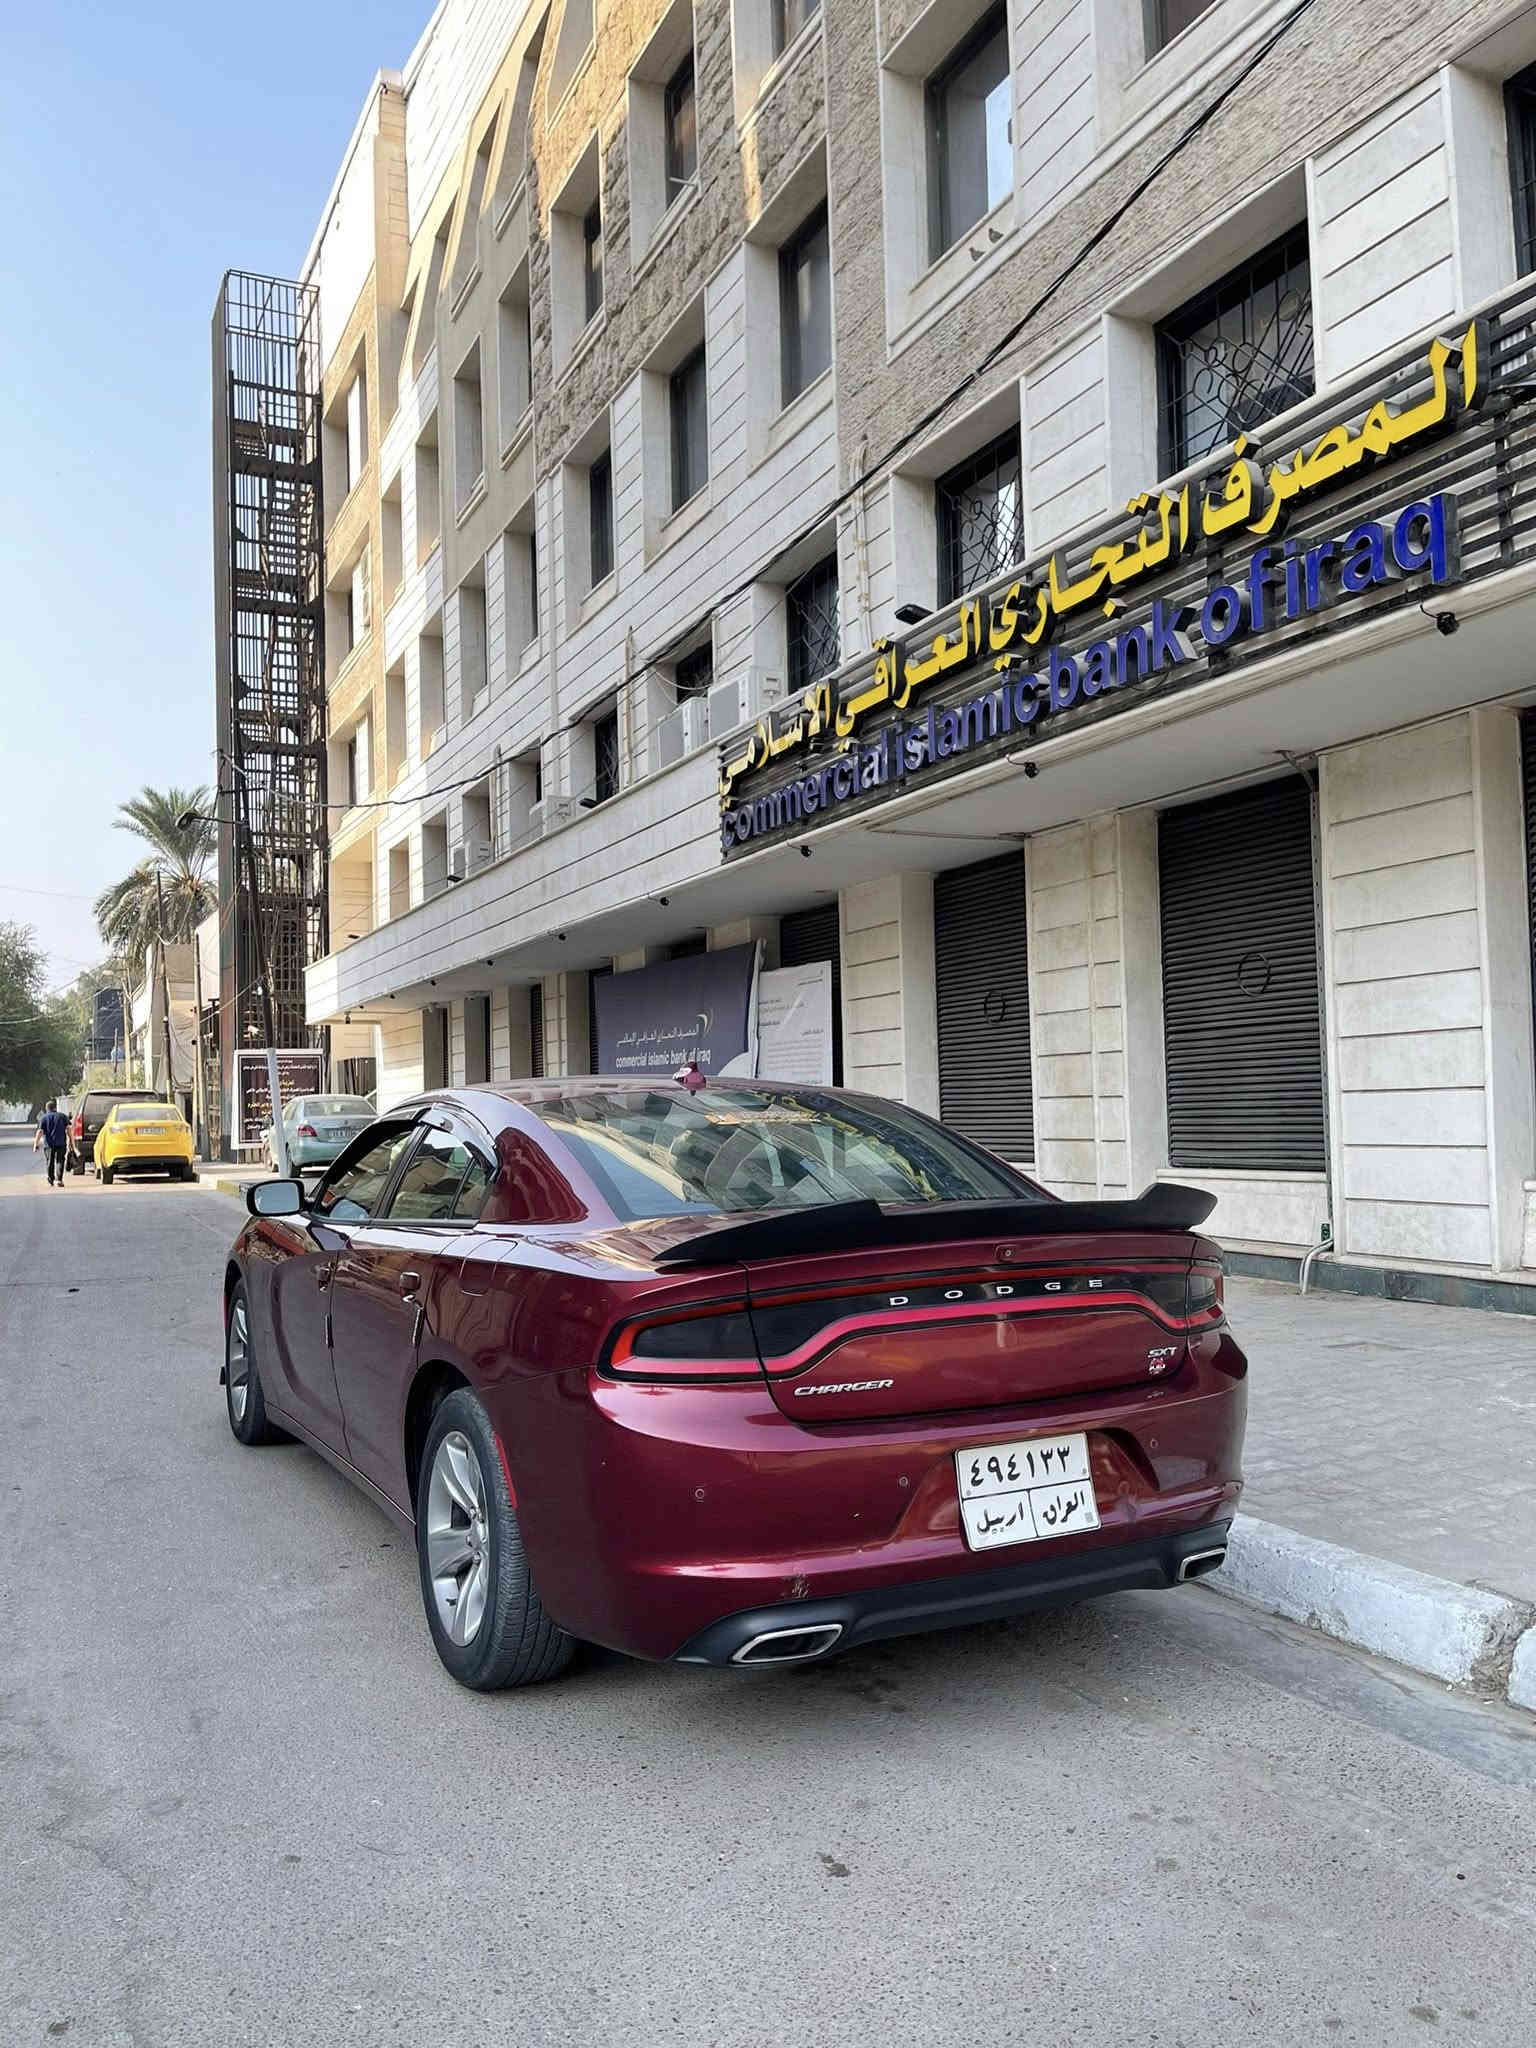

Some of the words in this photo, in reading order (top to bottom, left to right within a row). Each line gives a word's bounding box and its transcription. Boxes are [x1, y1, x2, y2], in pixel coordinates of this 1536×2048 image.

[1202, 320, 1477, 536] المصرف
[989, 482, 1189, 672] التجاري
[720, 729, 889, 848] commercial
[896, 668, 1041, 777] islamic
[1050, 599, 1187, 713] bank
[1201, 547, 1273, 645] of
[1283, 493, 1447, 618] iraq
[836, 596, 981, 753] العراقي
[889, 1278, 1103, 1307] DODGE
[1148, 1346, 1177, 1358] SXT
[793, 1378, 894, 1397] CHARGER
